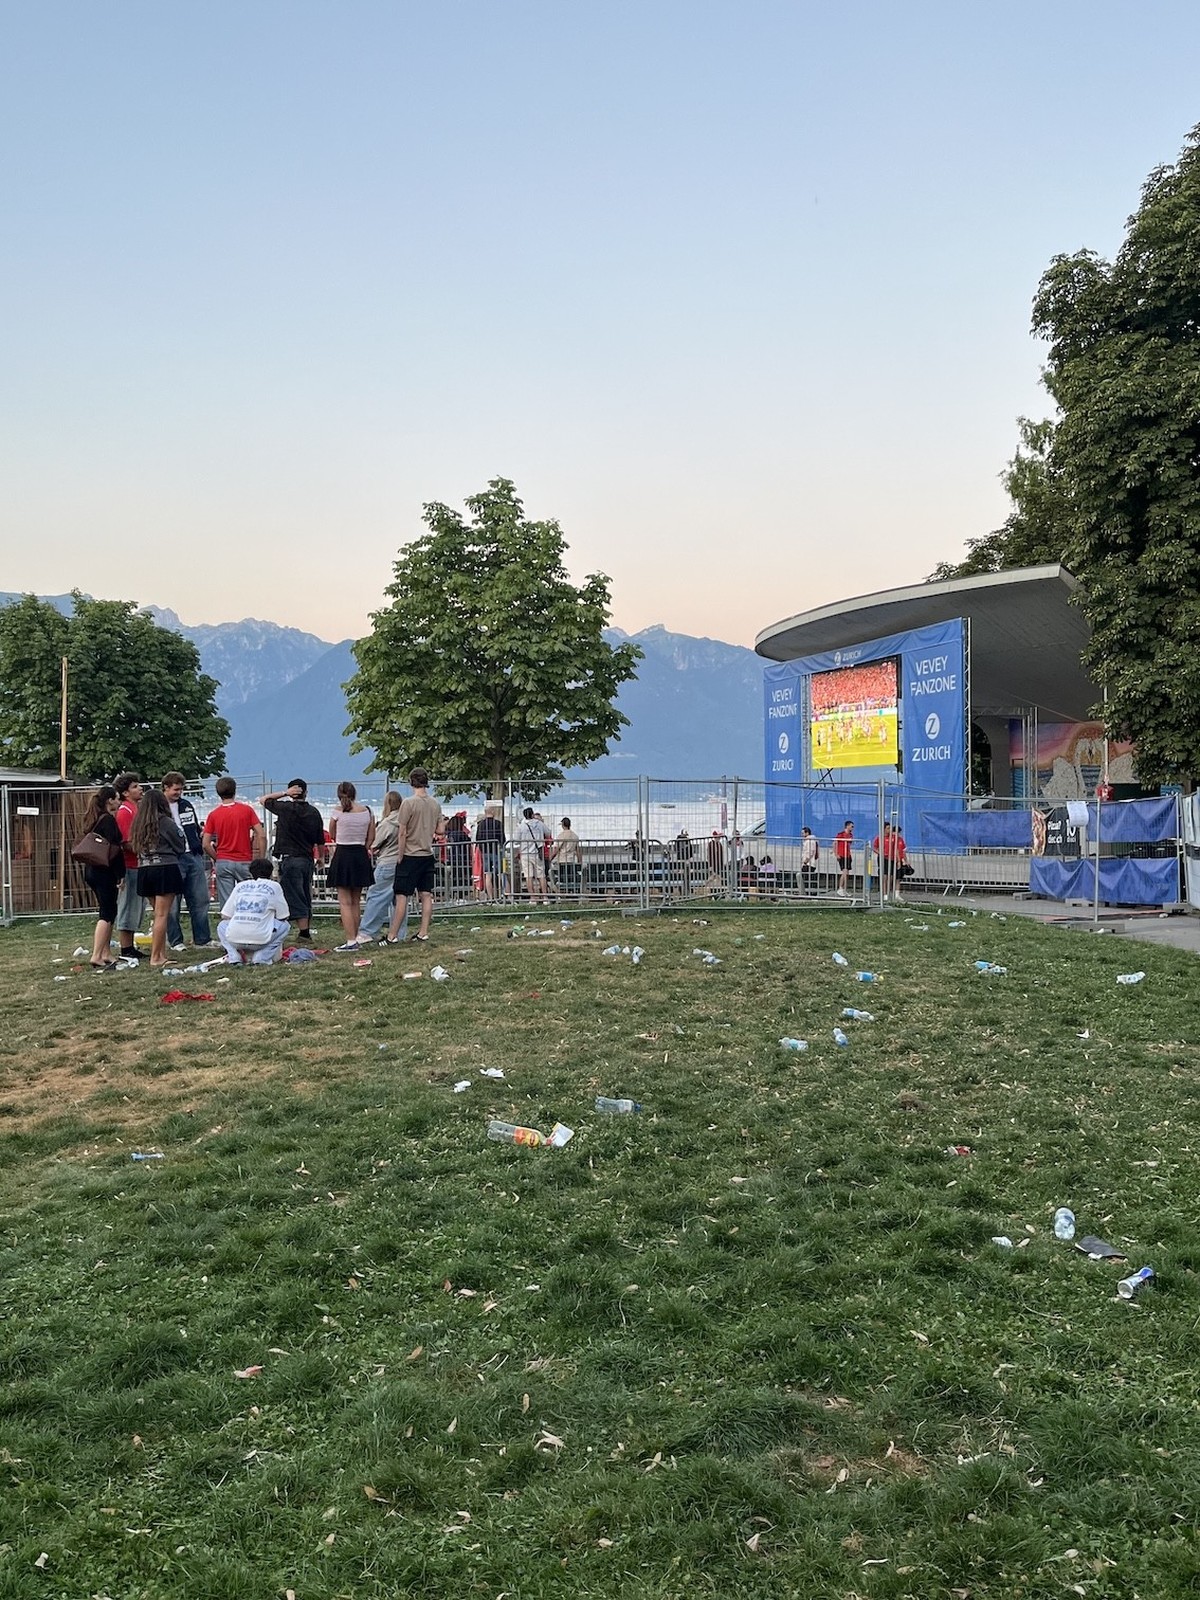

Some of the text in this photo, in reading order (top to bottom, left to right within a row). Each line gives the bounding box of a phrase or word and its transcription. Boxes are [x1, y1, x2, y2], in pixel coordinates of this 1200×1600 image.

[915, 655, 948, 676] VEVEY
[772, 687, 793, 703] VEVEY
[910, 675, 956, 697] FANZONE
[912, 745, 951, 762] ZURICH
